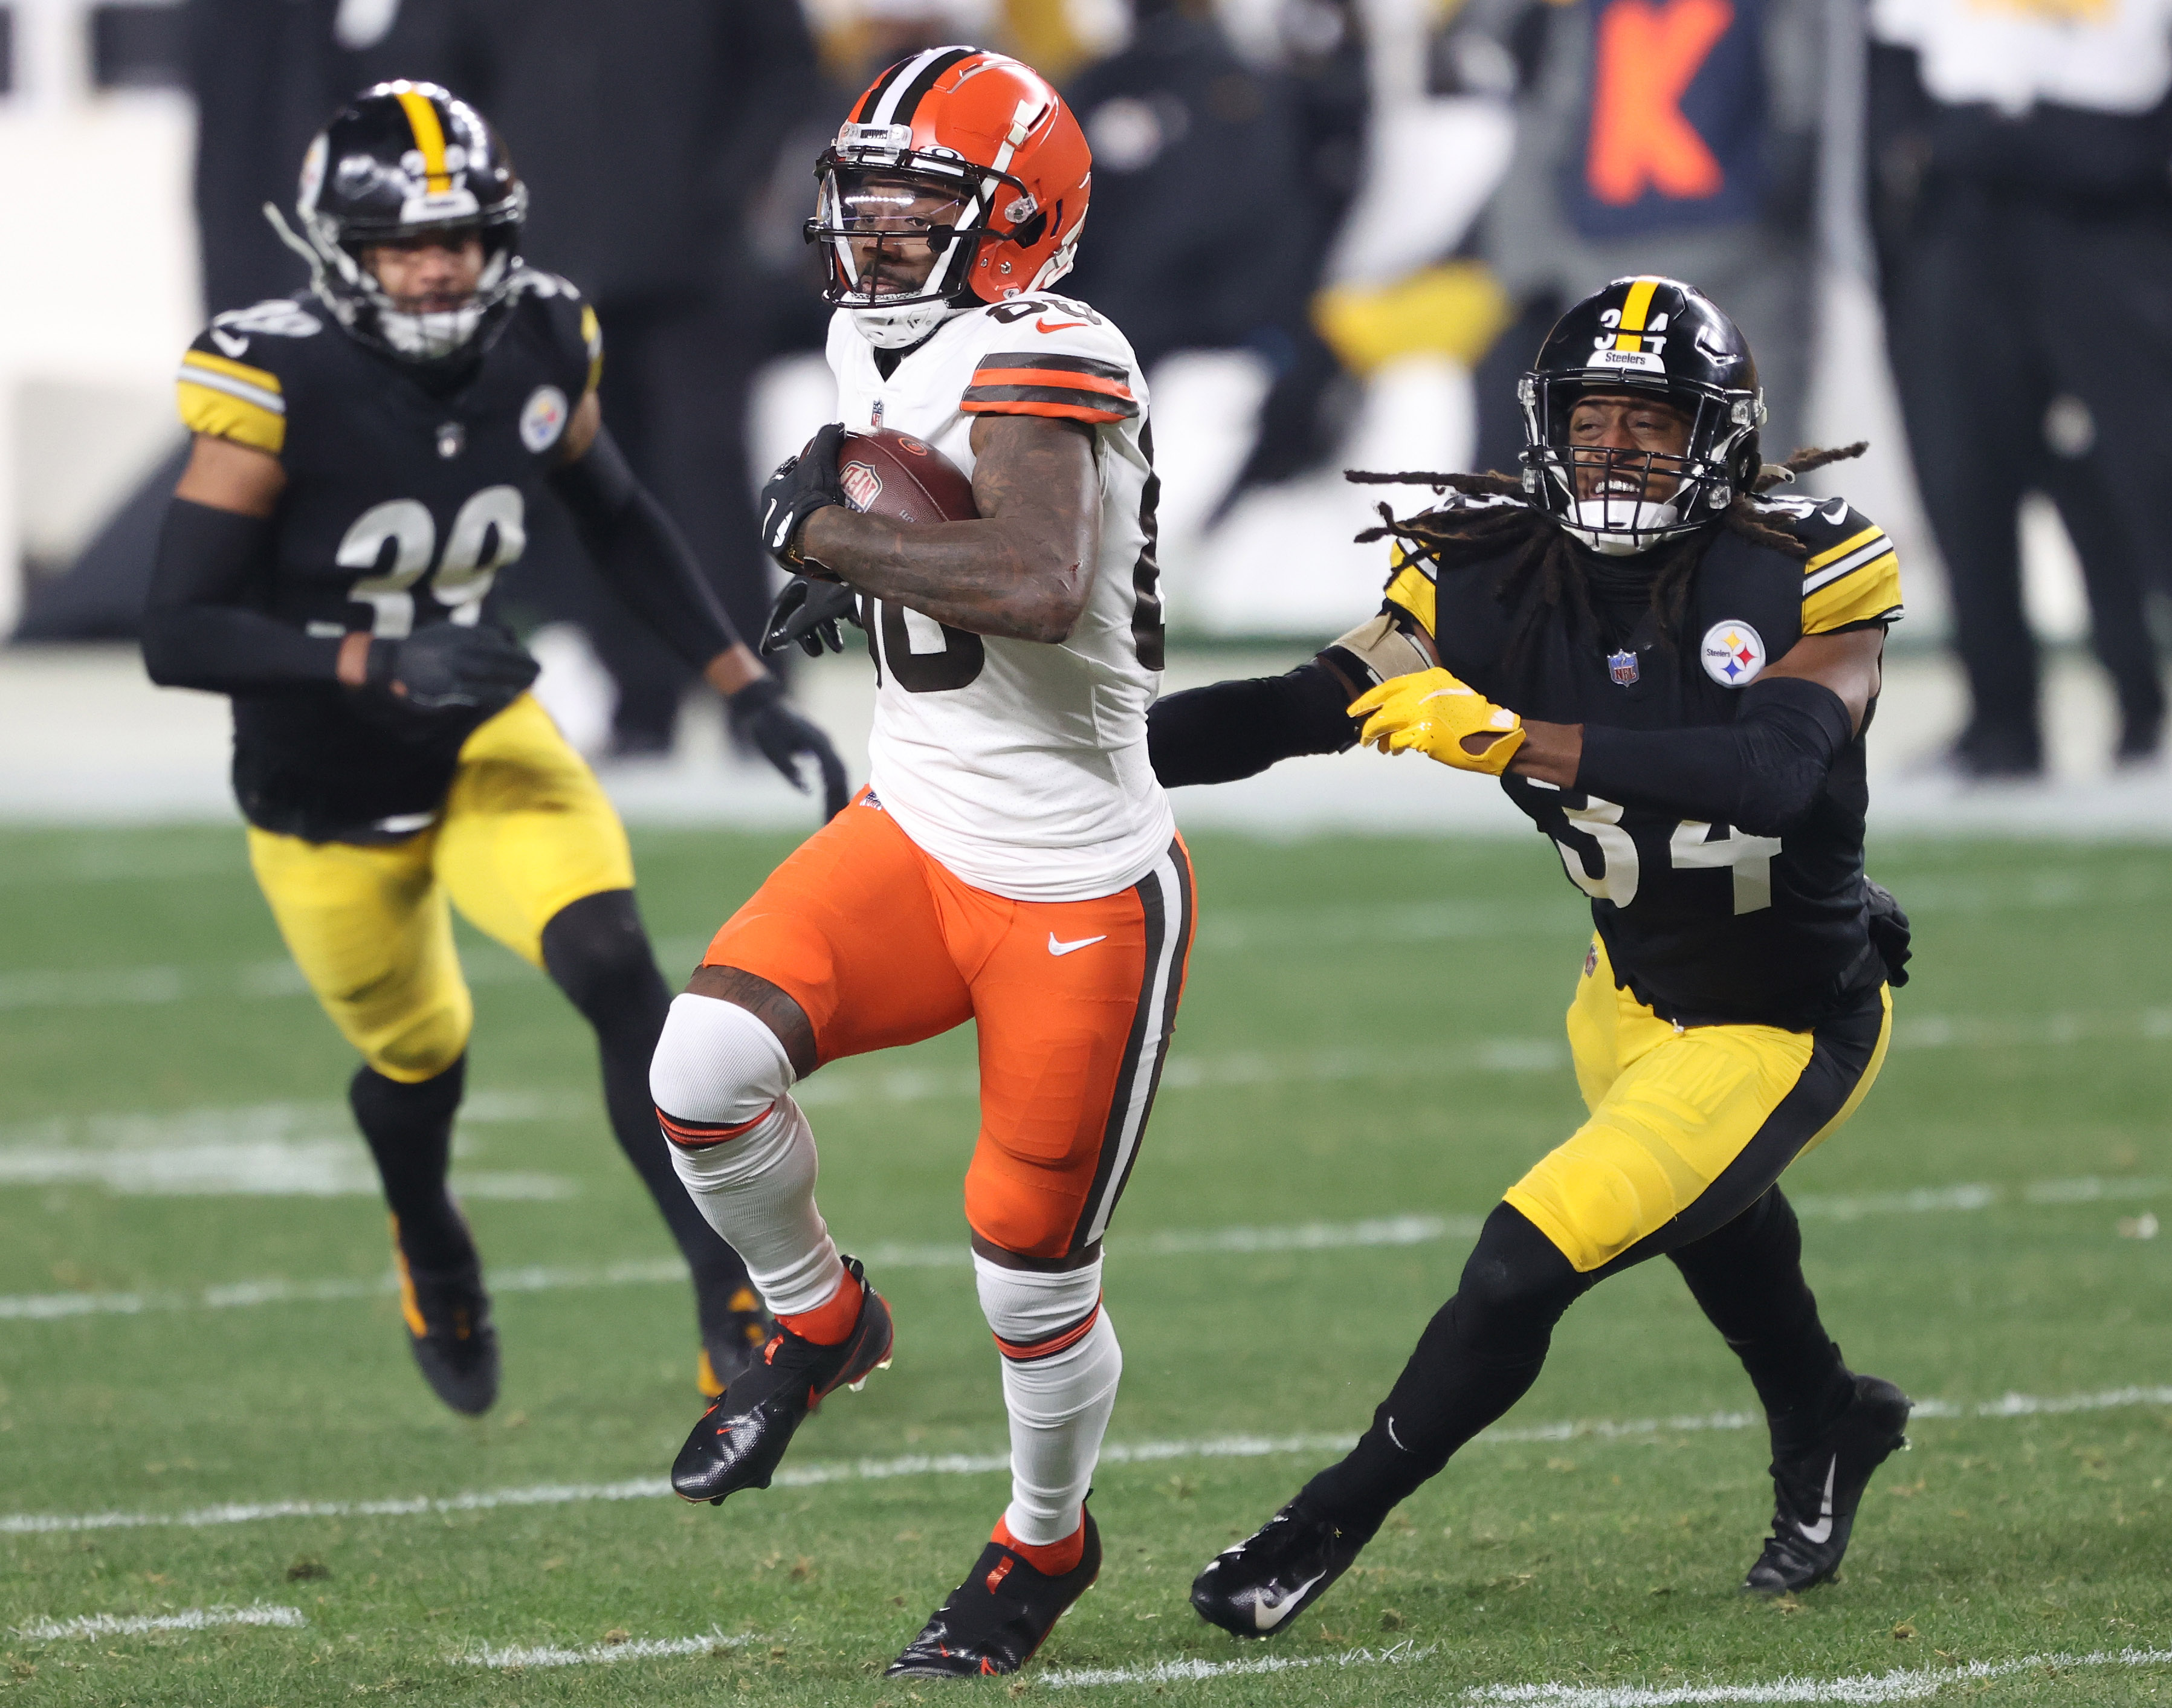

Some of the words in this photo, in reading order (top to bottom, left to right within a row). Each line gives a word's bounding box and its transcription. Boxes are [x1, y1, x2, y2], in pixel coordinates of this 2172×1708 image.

[1586, 0, 1734, 207] K
[1594, 308, 1669, 355] 34
[1605, 352, 1646, 365] Steelers
[844, 466, 876, 505] NFL
[1706, 649, 1731, 658] Steelers
[1614, 667, 1636, 682] NFL
